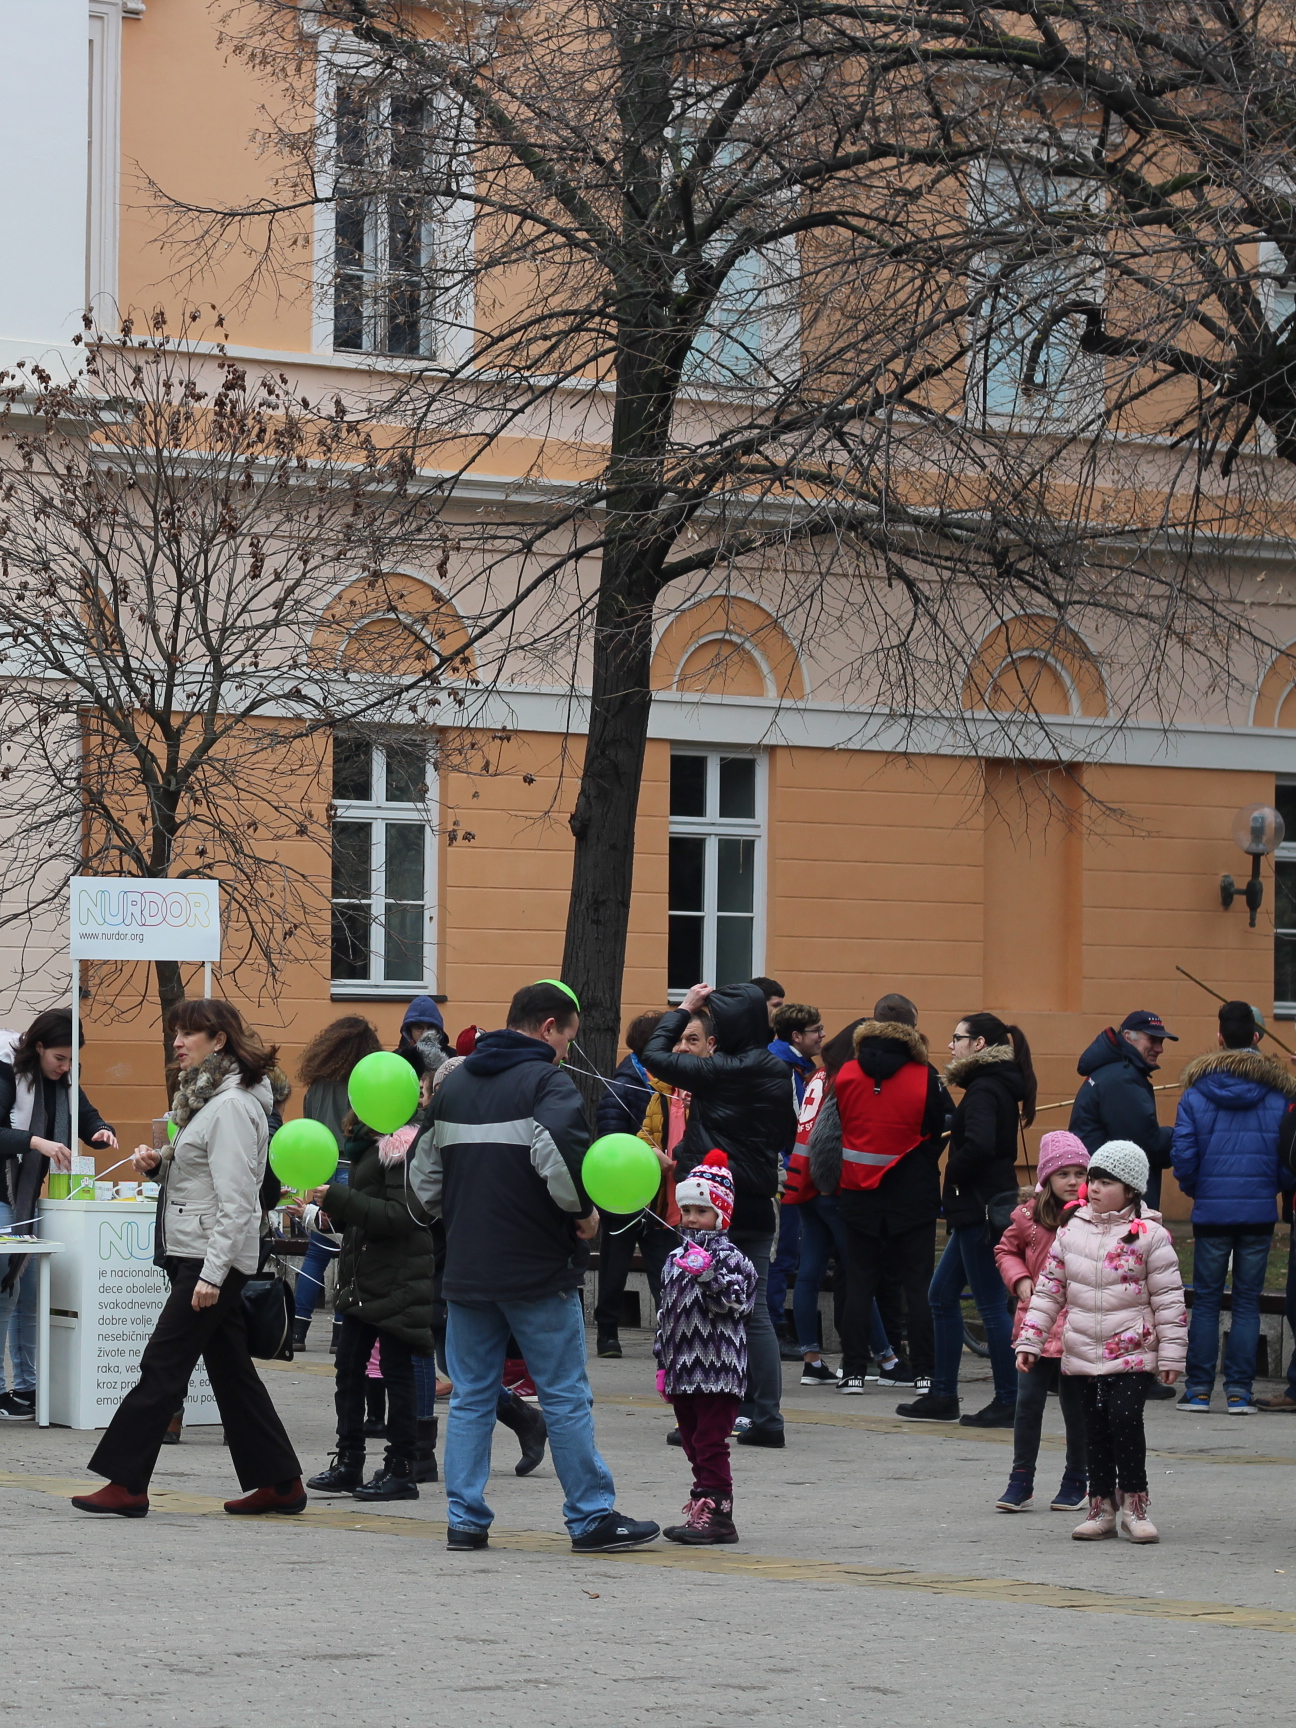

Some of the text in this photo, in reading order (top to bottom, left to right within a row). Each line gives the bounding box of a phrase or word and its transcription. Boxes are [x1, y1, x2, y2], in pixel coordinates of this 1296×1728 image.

[78, 889, 211, 928] NURDOR
[79, 930, 144, 943] www.nurdor.org
[98, 1267, 108, 1281] je
[98, 1282, 123, 1294] dece
[125, 1282, 162, 1294] obolele
[97, 1298, 164, 1310] svakodnevno
[97, 1314, 155, 1328] dobre volje,
[97, 1346, 141, 1358] živote ne
[96, 1362, 122, 1375] raka,
[96, 1378, 118, 1390] kroz
[916, 1379, 931, 1387] NIKE
